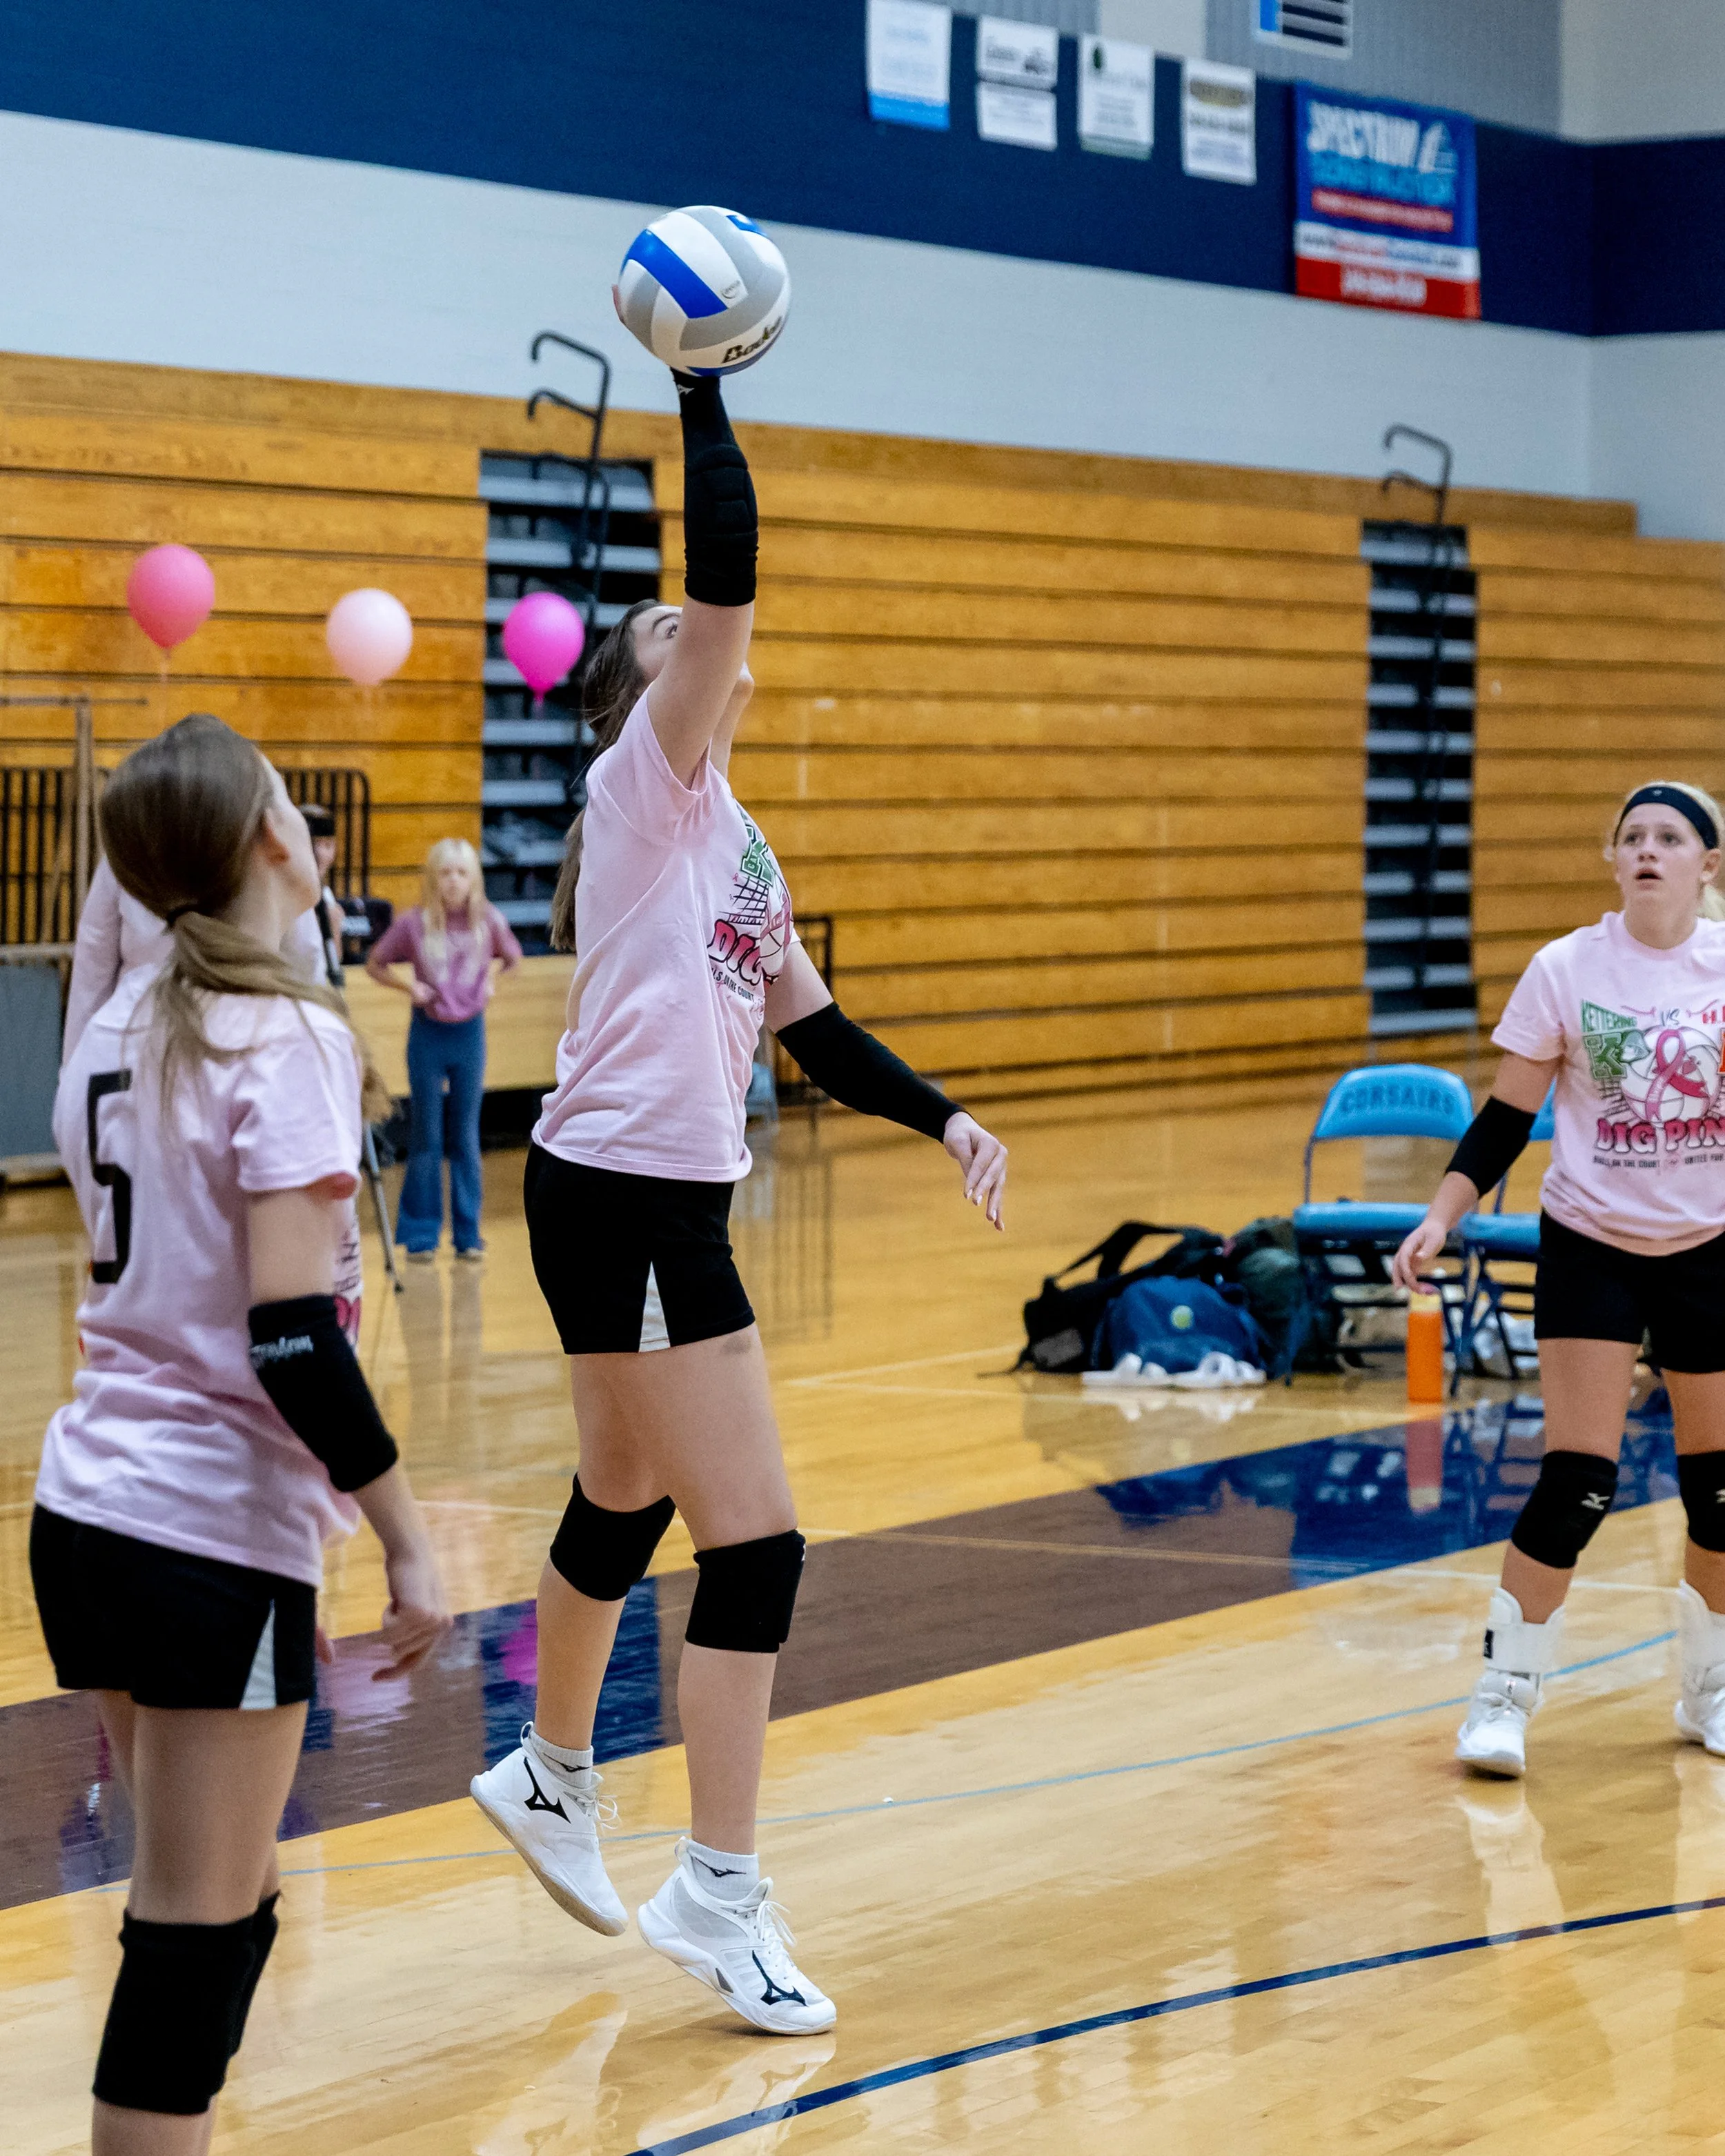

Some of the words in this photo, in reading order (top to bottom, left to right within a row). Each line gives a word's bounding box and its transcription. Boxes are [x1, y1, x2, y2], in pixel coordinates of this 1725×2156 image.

[1581, 998, 1638, 1033] KETTERING
[1660, 1008, 1680, 1026] VS
[1341, 1085, 1454, 1115] CORSAIRS
[1664, 1116, 1725, 1152] PIN
[88, 1069, 131, 1284] 5
